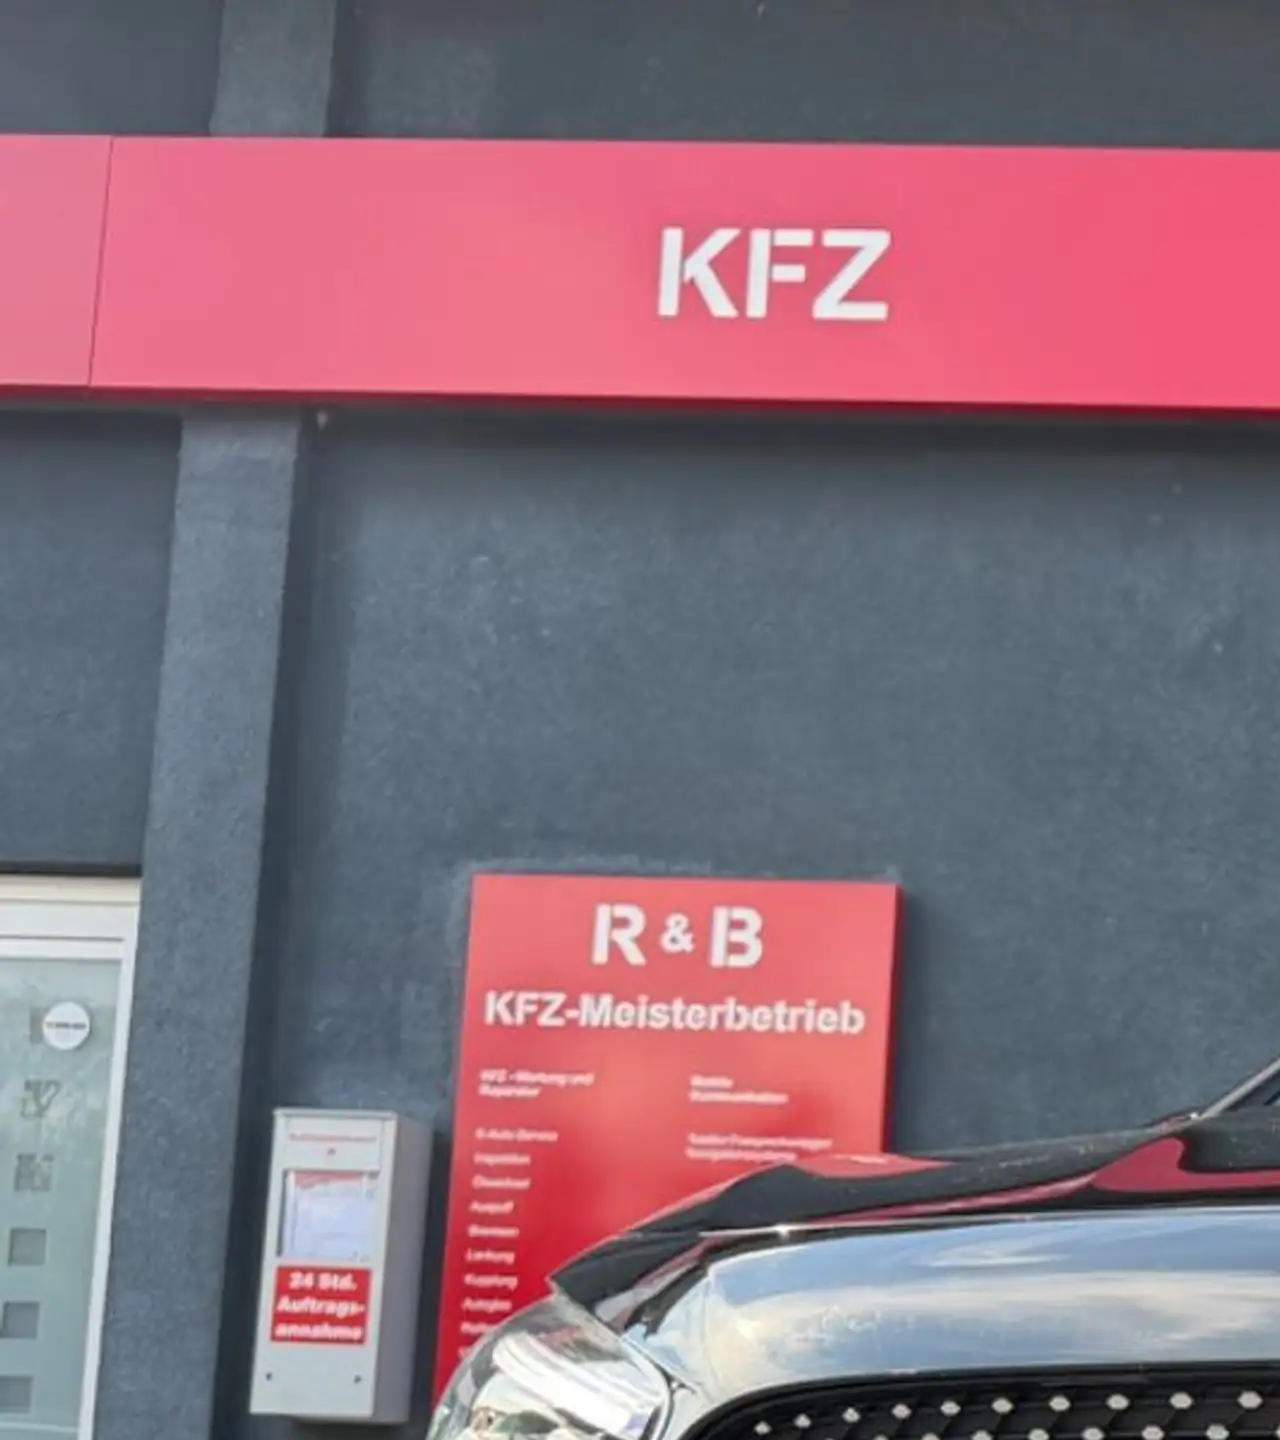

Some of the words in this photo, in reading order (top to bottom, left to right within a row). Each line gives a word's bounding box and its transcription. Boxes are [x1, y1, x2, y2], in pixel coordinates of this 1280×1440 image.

[657, 227, 891, 321] KFZ
[592, 903, 646, 965] R
[660, 913, 694, 953] &
[710, 906, 763, 968] B
[484, 991, 866, 1035] KFZ-Meisterbetrieb
